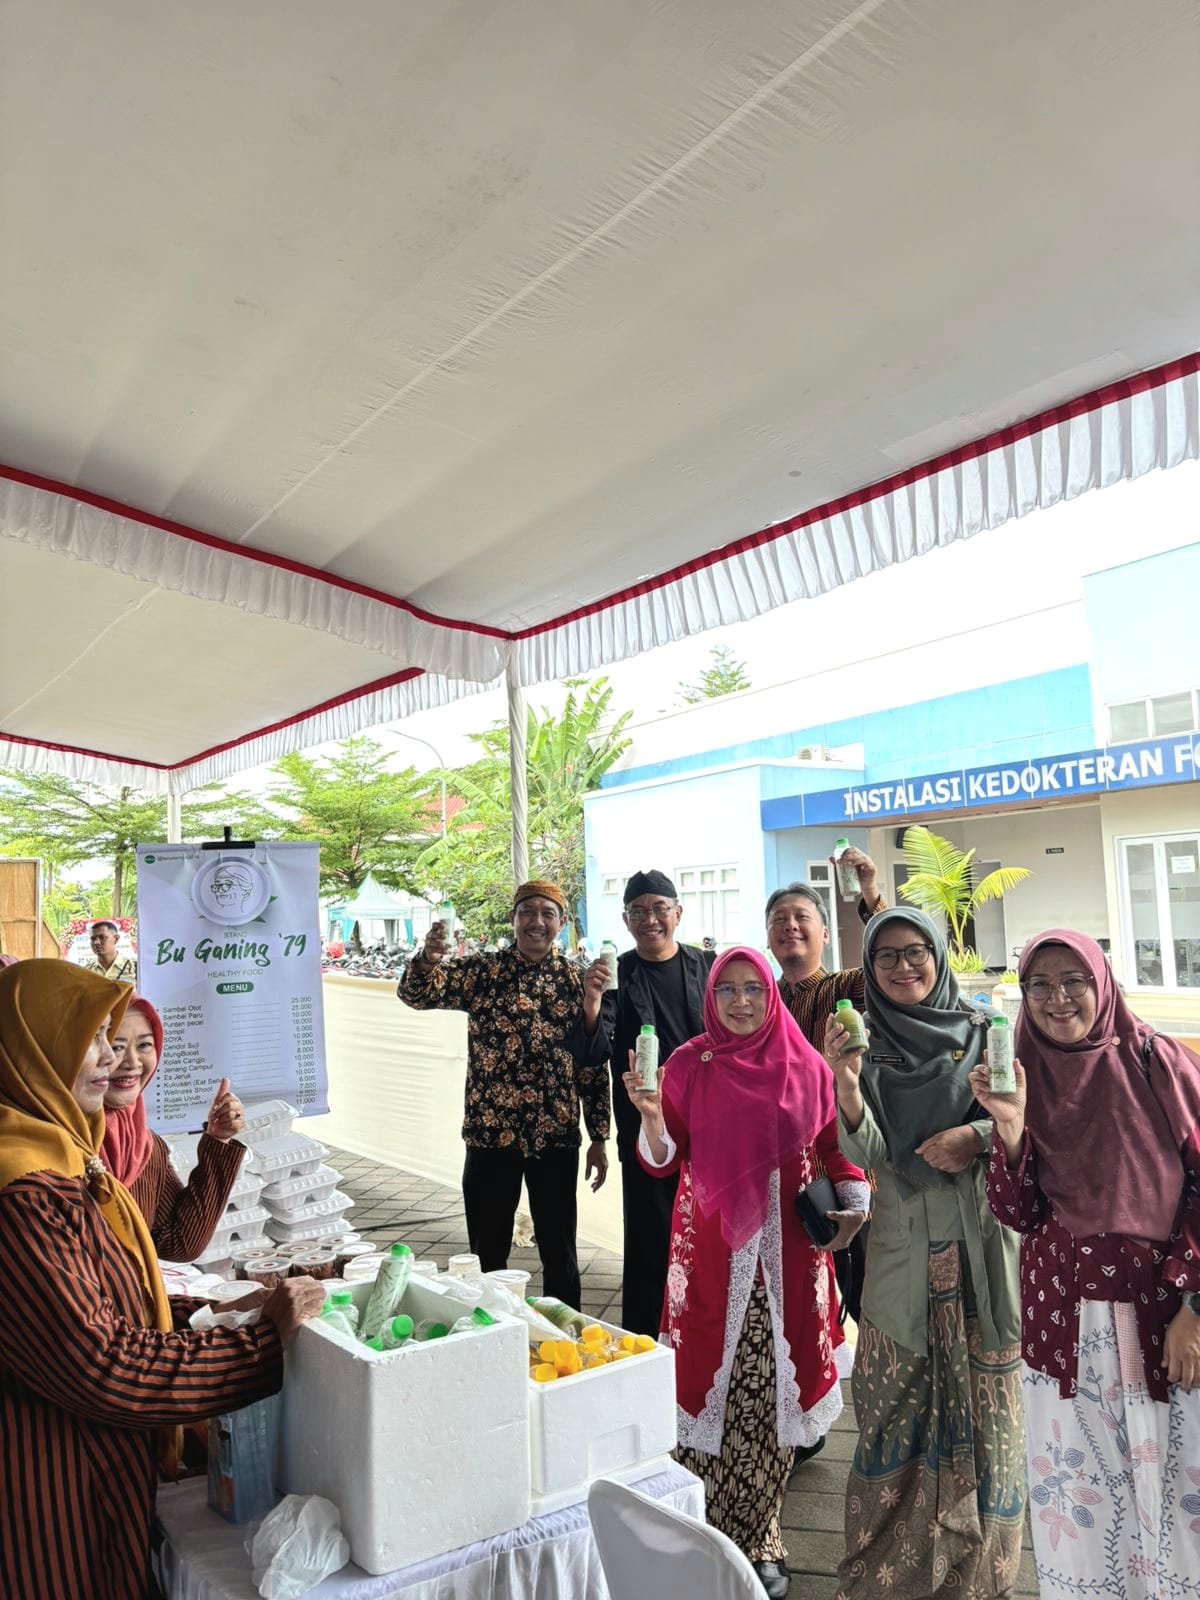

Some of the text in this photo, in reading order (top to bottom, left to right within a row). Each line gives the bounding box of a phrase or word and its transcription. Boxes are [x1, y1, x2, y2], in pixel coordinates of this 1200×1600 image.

[844, 777, 962, 815] INSTALASI
[969, 747, 1162, 800] KEDOKTERAN
[224, 931, 247, 939] STAND
[155, 938, 186, 966] Bu
[194, 937, 271, 967] Ganing
[207, 968, 263, 979] HEALTHY FOOD
[223, 983, 248, 992] MENU
